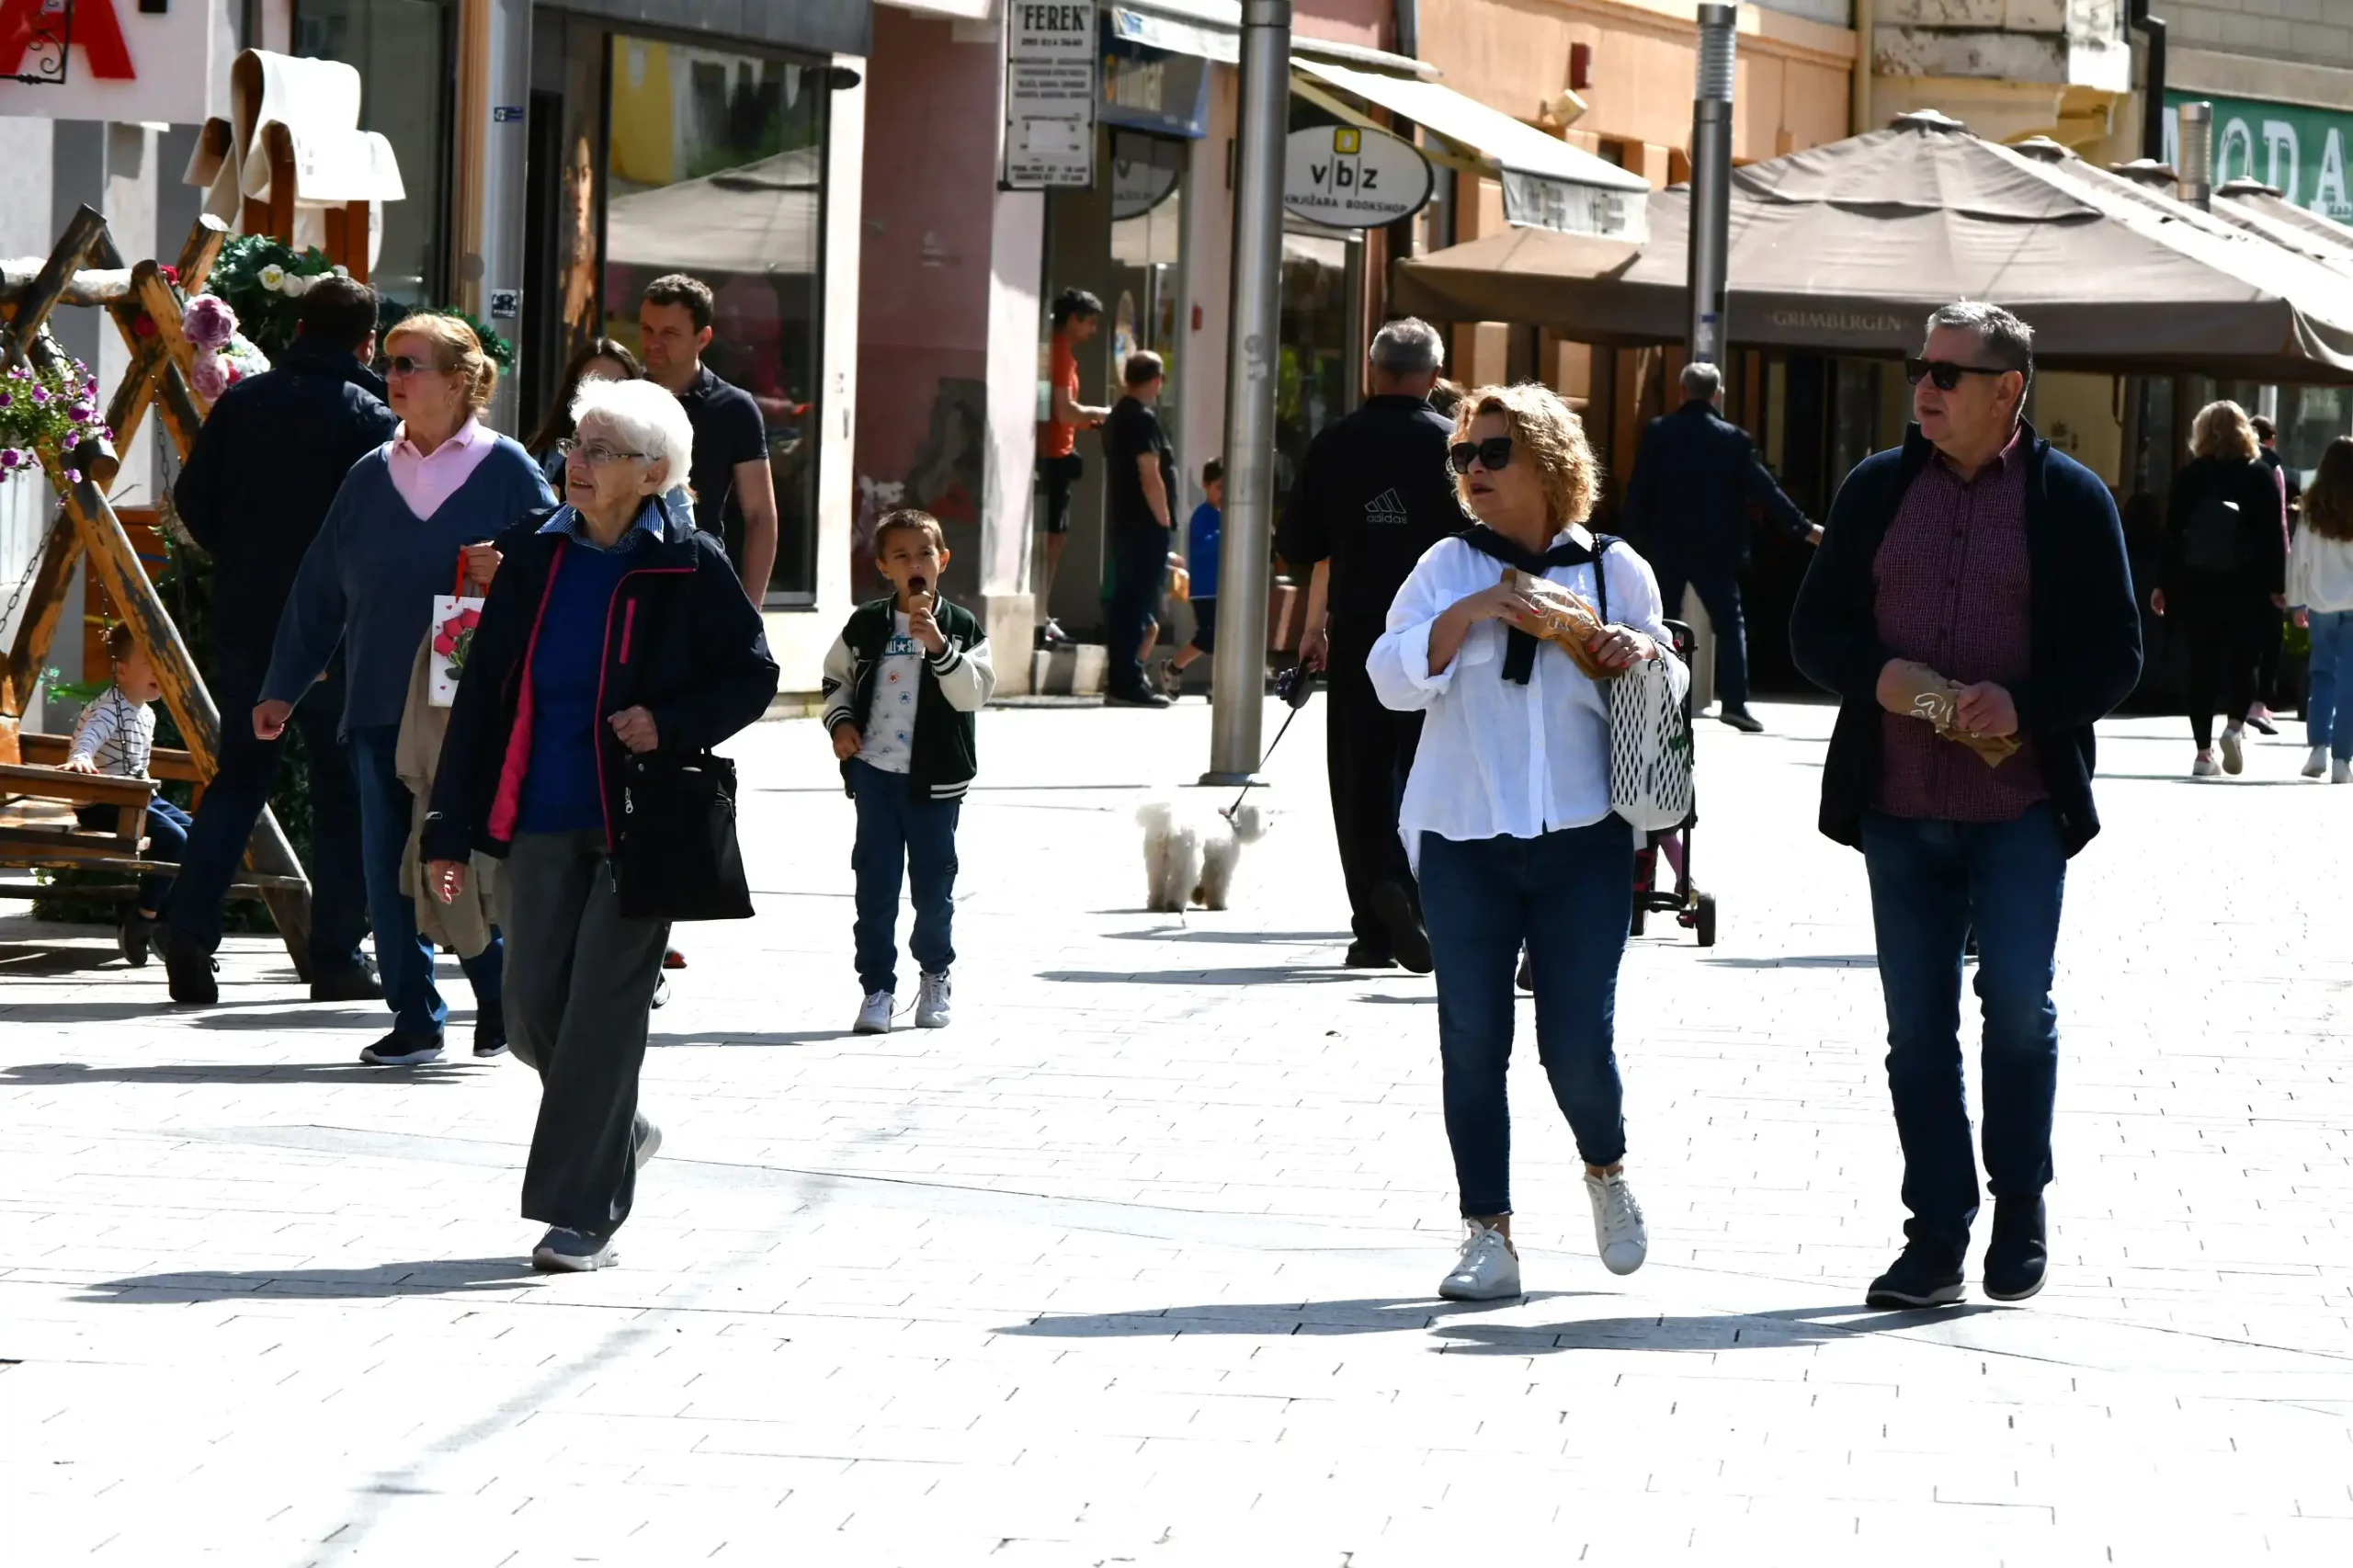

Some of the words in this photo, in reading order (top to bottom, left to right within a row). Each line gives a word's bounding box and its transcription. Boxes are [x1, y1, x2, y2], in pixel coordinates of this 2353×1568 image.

[1346, 199, 1407, 213] BOOKSHOP
[1772, 310, 1901, 332] GRIMBERGEN
[1367, 513, 1407, 524] adidas
